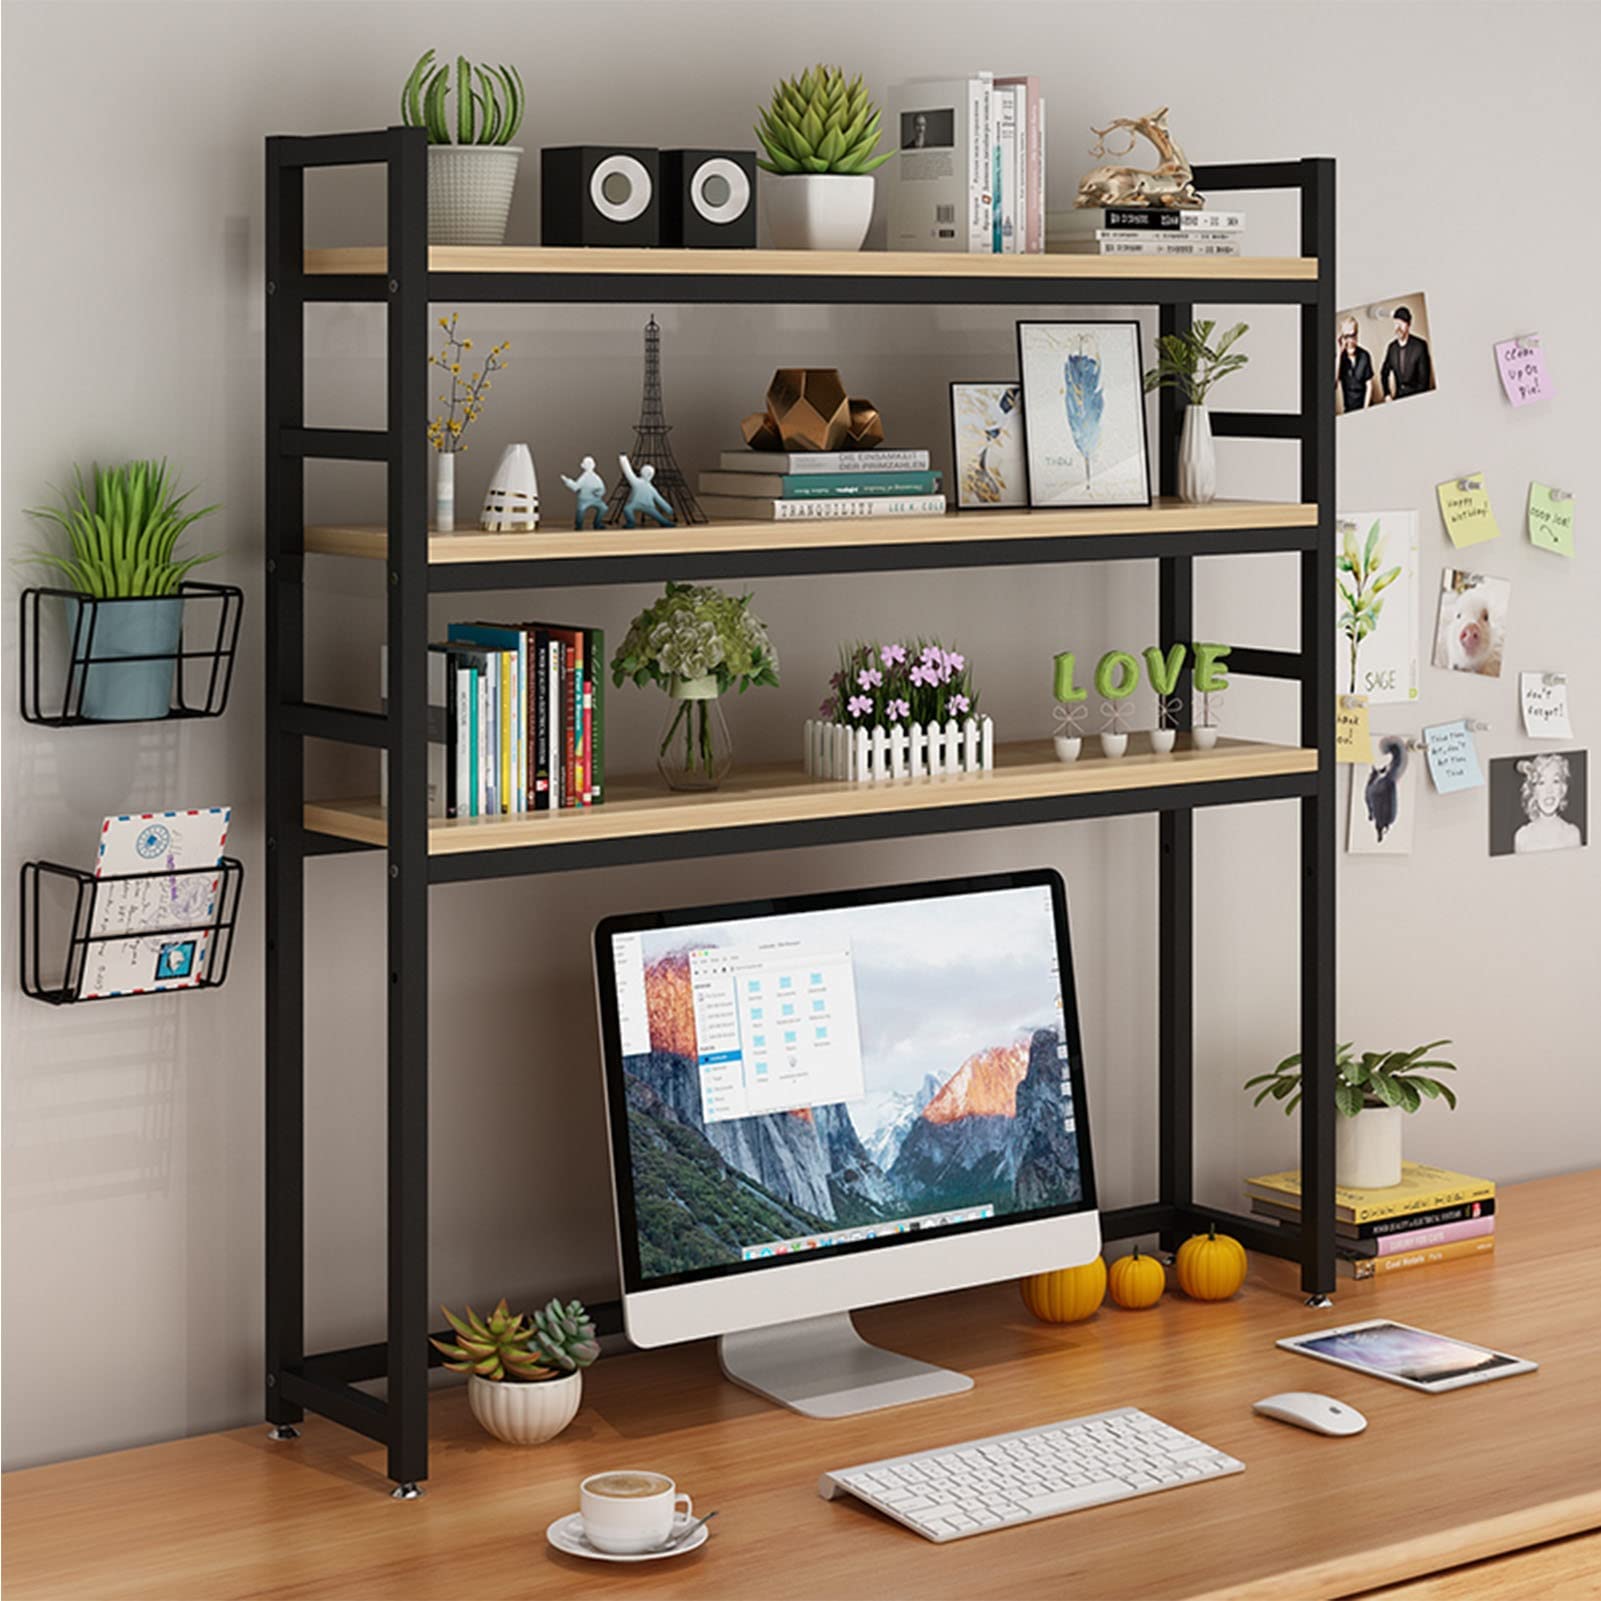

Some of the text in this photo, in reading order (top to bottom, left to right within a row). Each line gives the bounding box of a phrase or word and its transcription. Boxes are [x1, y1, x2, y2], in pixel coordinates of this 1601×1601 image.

[781, 502, 874, 517] TRANQUILITY
[1053, 642, 1232, 703] LOVE
[1364, 669, 1397, 692] SAGE
